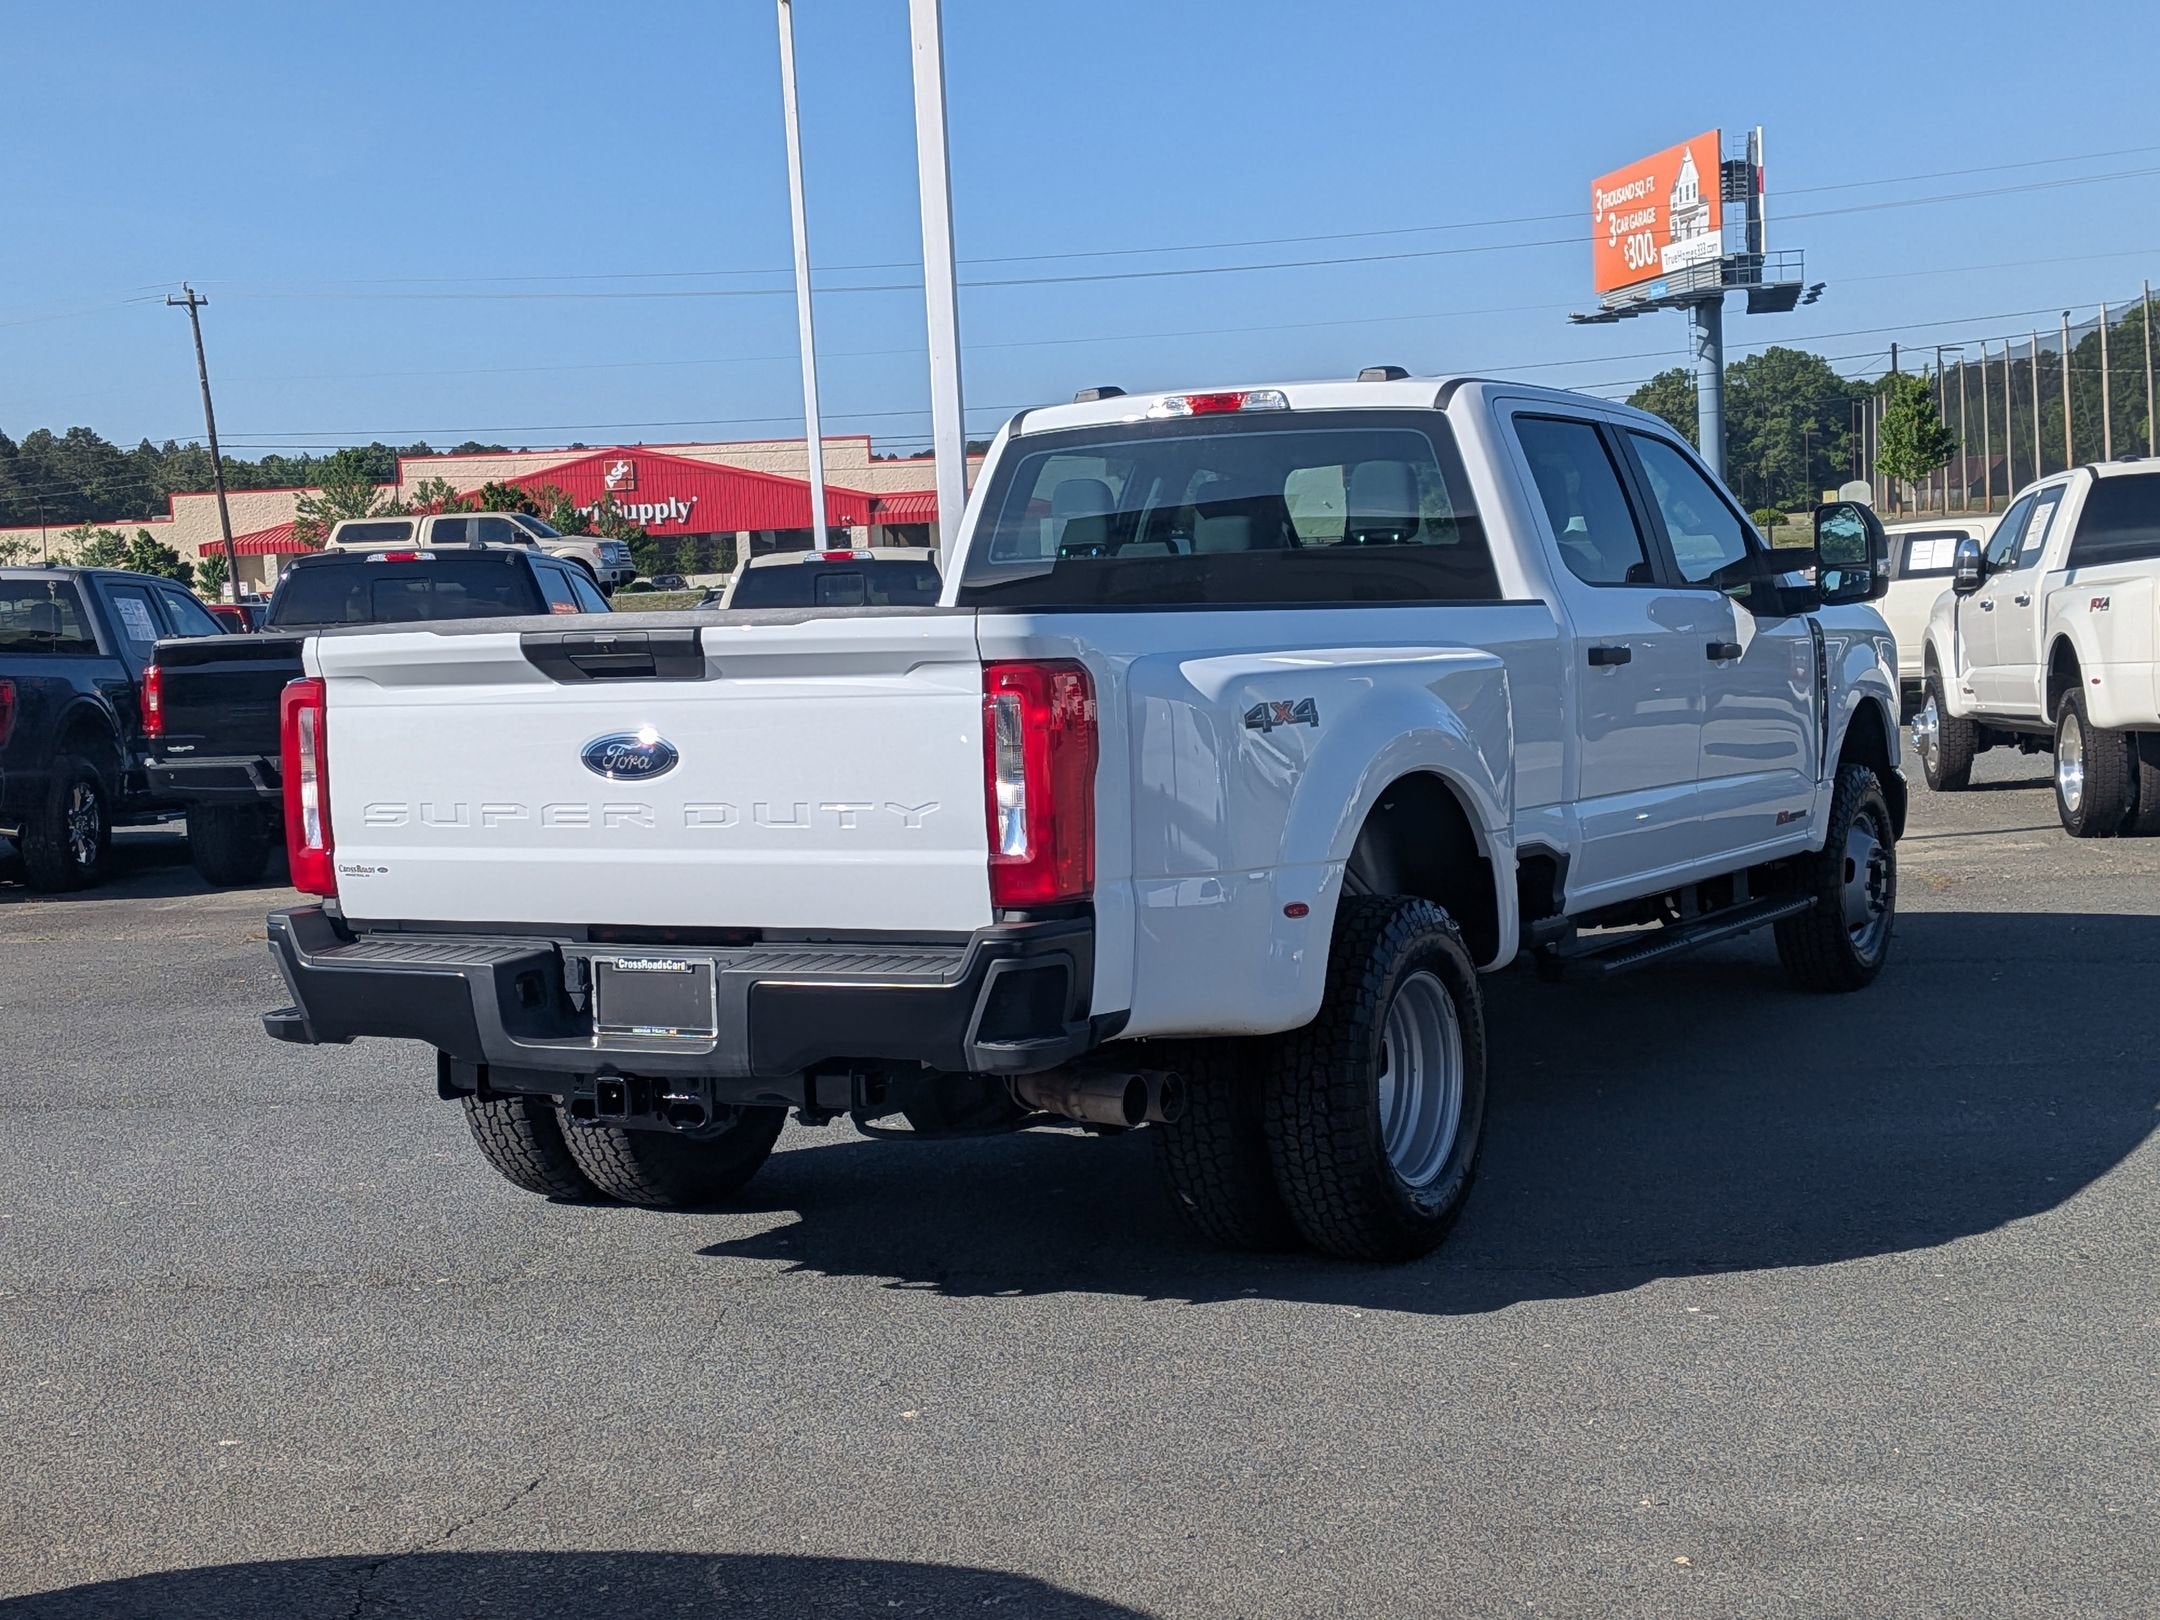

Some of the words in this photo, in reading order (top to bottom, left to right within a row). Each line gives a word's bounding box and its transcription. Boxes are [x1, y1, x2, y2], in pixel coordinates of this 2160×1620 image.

[1596, 188, 1603, 223] 3
[1602, 183, 1635, 210] THOUSAND
[1608, 212, 1617, 248] 3
[1616, 216, 1630, 234] CAR
[1629, 207, 1657, 230] GARAGE
[602, 740, 653, 770] Ford
[363, 802, 655, 829] SUPER
[683, 801, 940, 830] DUTY
